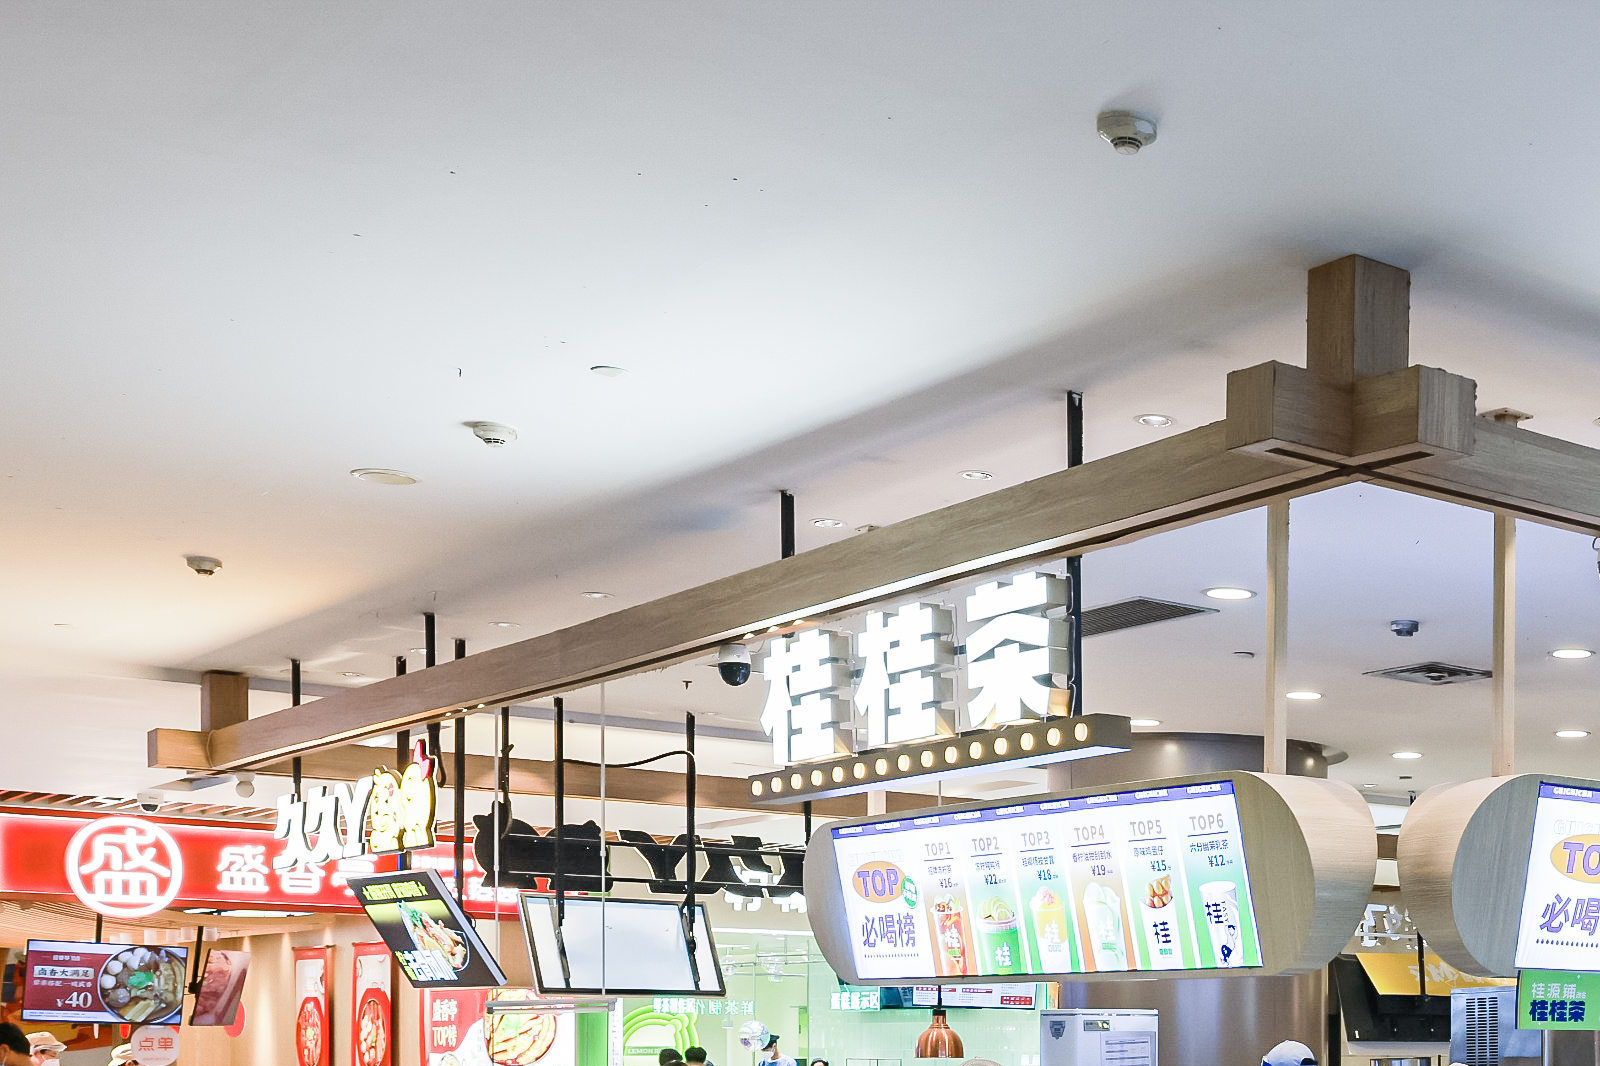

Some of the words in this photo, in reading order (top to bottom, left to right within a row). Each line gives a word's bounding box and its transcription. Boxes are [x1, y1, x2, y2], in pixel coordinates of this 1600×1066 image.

[759, 571, 1049, 766] 桂桂茶
[1553, 787, 1593, 798] GUIGUICHA
[1130, 819, 1162, 837] TOP5
[1189, 813, 1224, 832] TOP6
[1021, 831, 1050, 847] TOP3
[1074, 825, 1105, 842] TOP4
[925, 842, 951, 857] TOP1
[972, 837, 999, 852] TOP2
[79, 827, 172, 898] 盛
[857, 869, 899, 897] TOP
[1205, 901, 1224, 924] 桂
[862, 912, 916, 948] 必喝榜
[1153, 921, 1171, 944] 桂
[56, 991, 93, 1009] ¥40
[1531, 983, 1577, 999] 桂源铺
[1529, 1000, 1585, 1023] 桂桂茶
[138, 1036, 174, 1051] 点单
